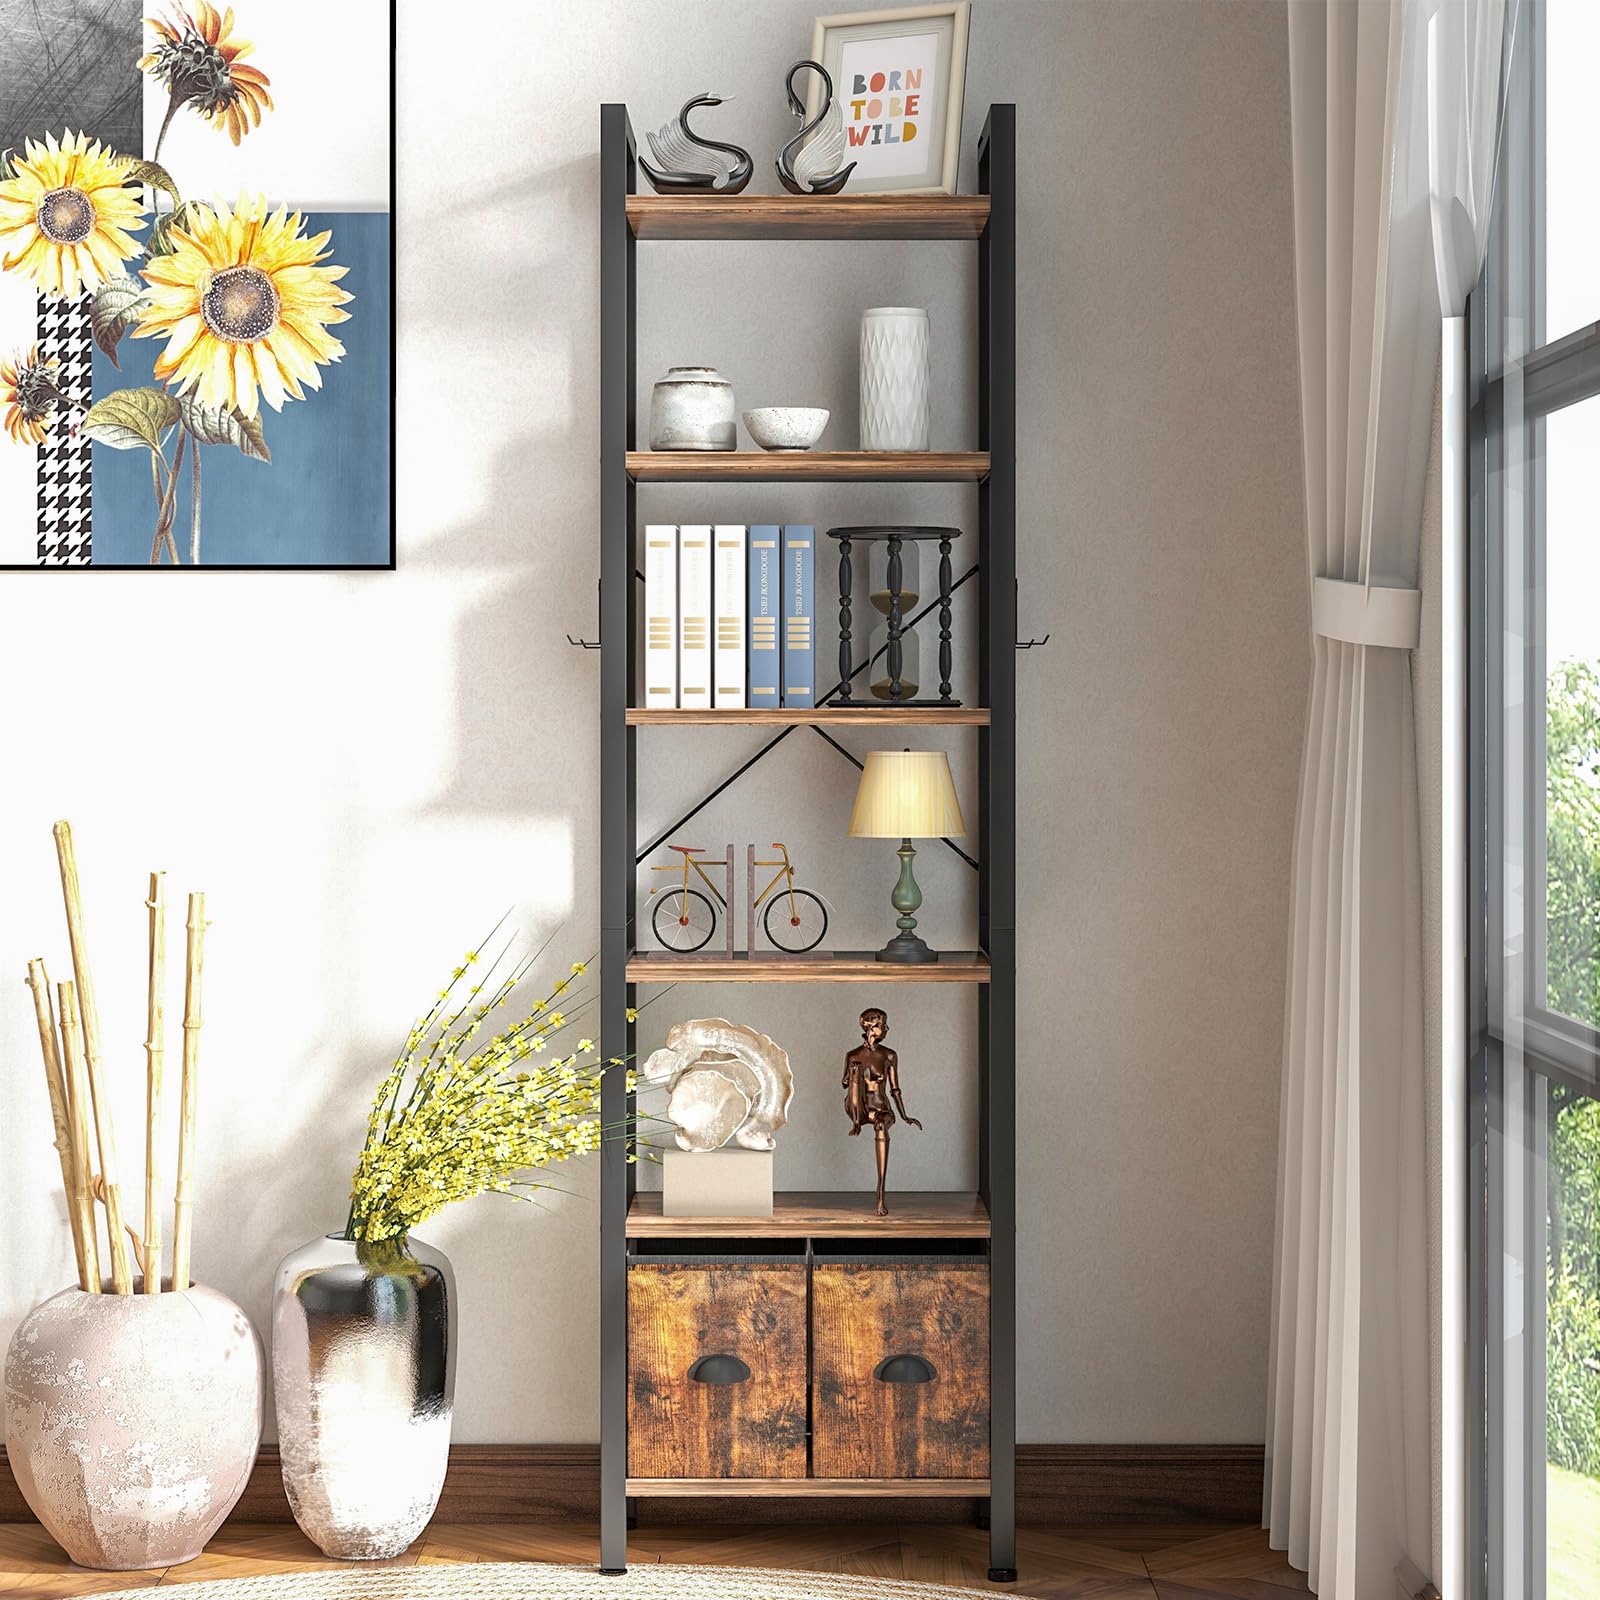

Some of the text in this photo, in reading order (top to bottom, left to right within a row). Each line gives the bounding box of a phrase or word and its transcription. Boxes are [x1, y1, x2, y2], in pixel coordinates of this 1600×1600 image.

[852, 68, 923, 95] BORN
[850, 94, 921, 121] TO BE
[847, 121, 918, 147] WILD
